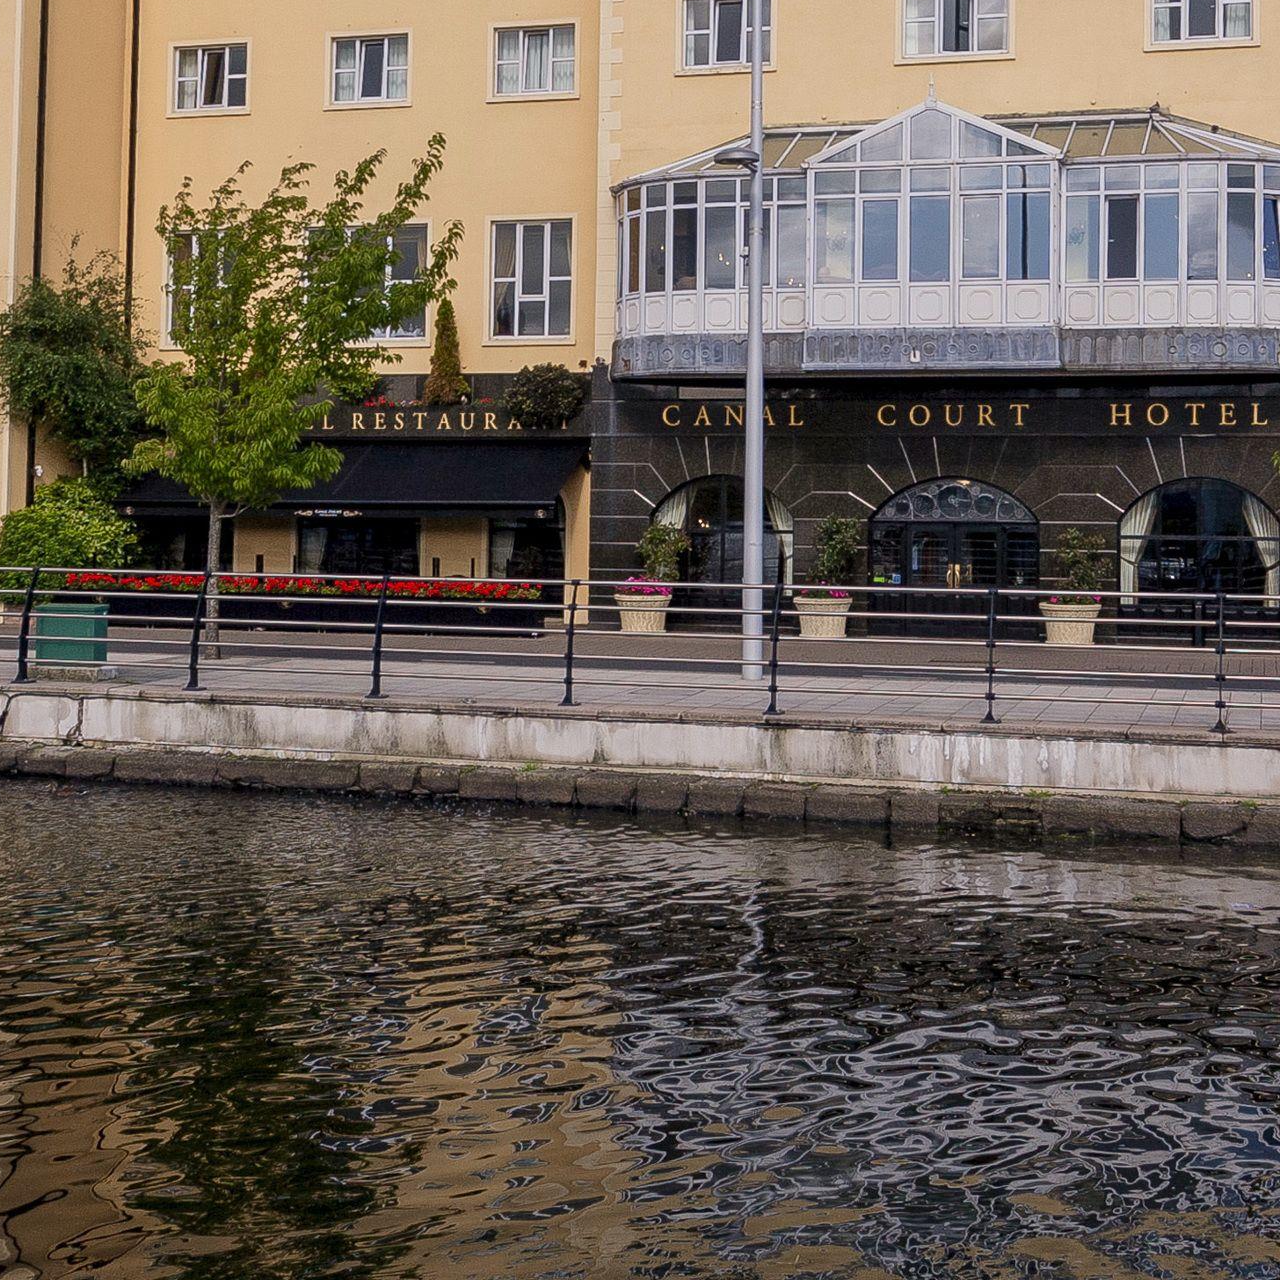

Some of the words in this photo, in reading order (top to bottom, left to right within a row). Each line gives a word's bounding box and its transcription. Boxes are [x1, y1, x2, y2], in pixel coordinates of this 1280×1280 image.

[352, 412, 568, 430] RESTAURA
[662, 404, 805, 426] CANAL
[876, 404, 1030, 426] COURT
[1109, 403, 1268, 426] HOTEL
